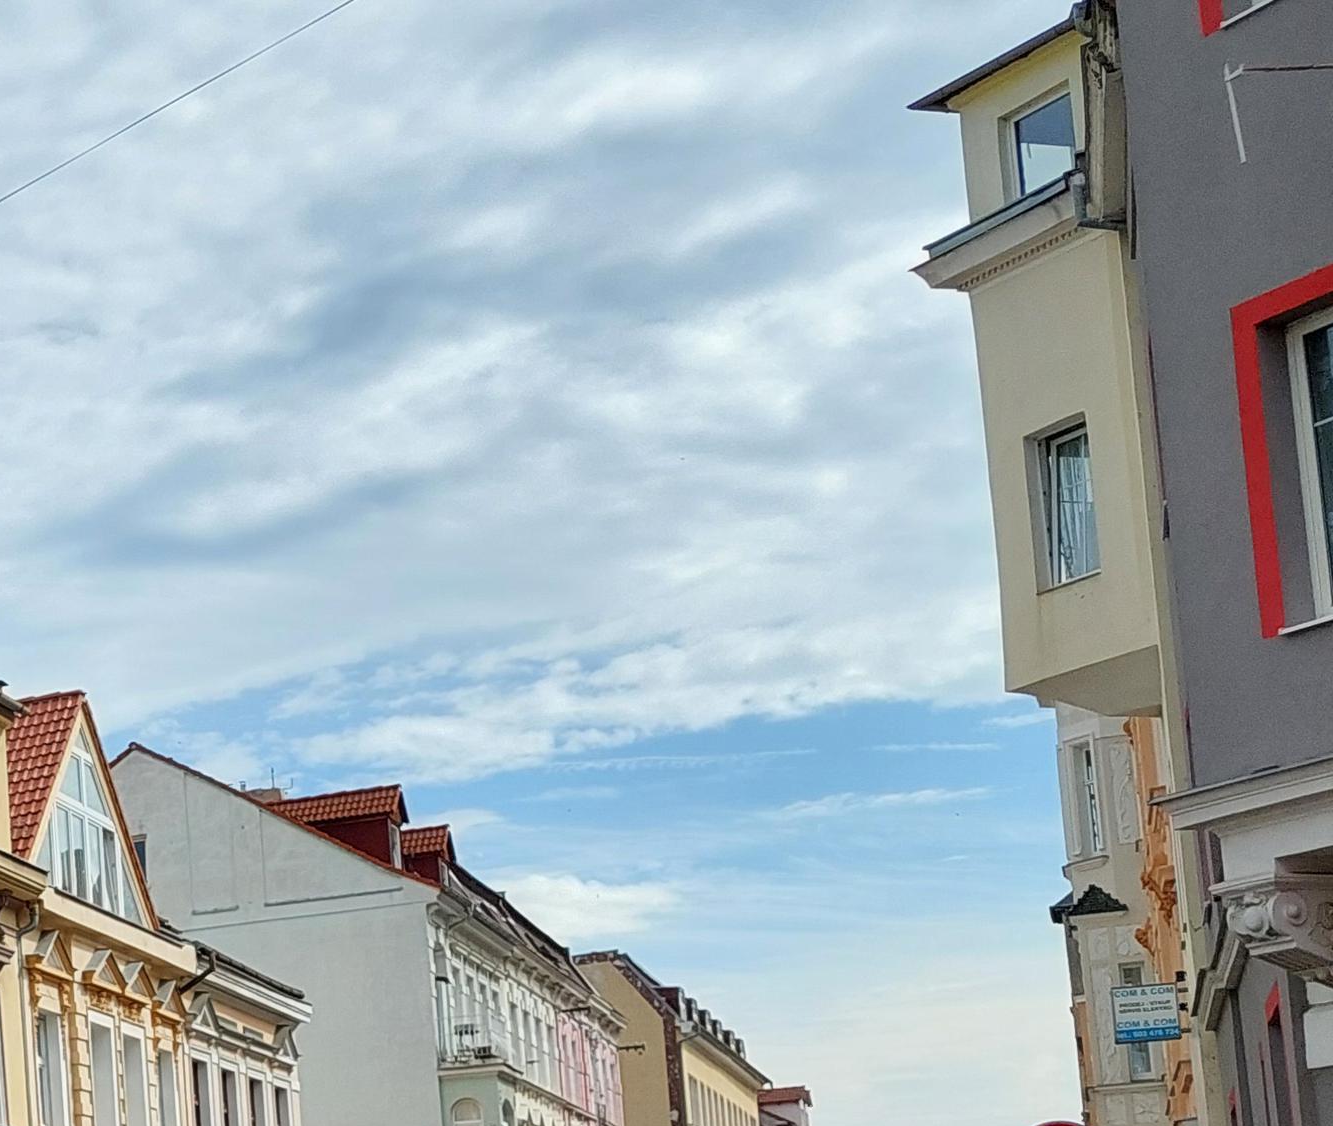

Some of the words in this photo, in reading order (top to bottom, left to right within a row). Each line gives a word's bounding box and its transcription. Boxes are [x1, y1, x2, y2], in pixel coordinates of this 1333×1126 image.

[1114, 990, 1138, 998] COM
[1150, 987, 1174, 995] COM
[1117, 1020, 1140, 1029] COM
[1153, 1018, 1177, 1026] COM
